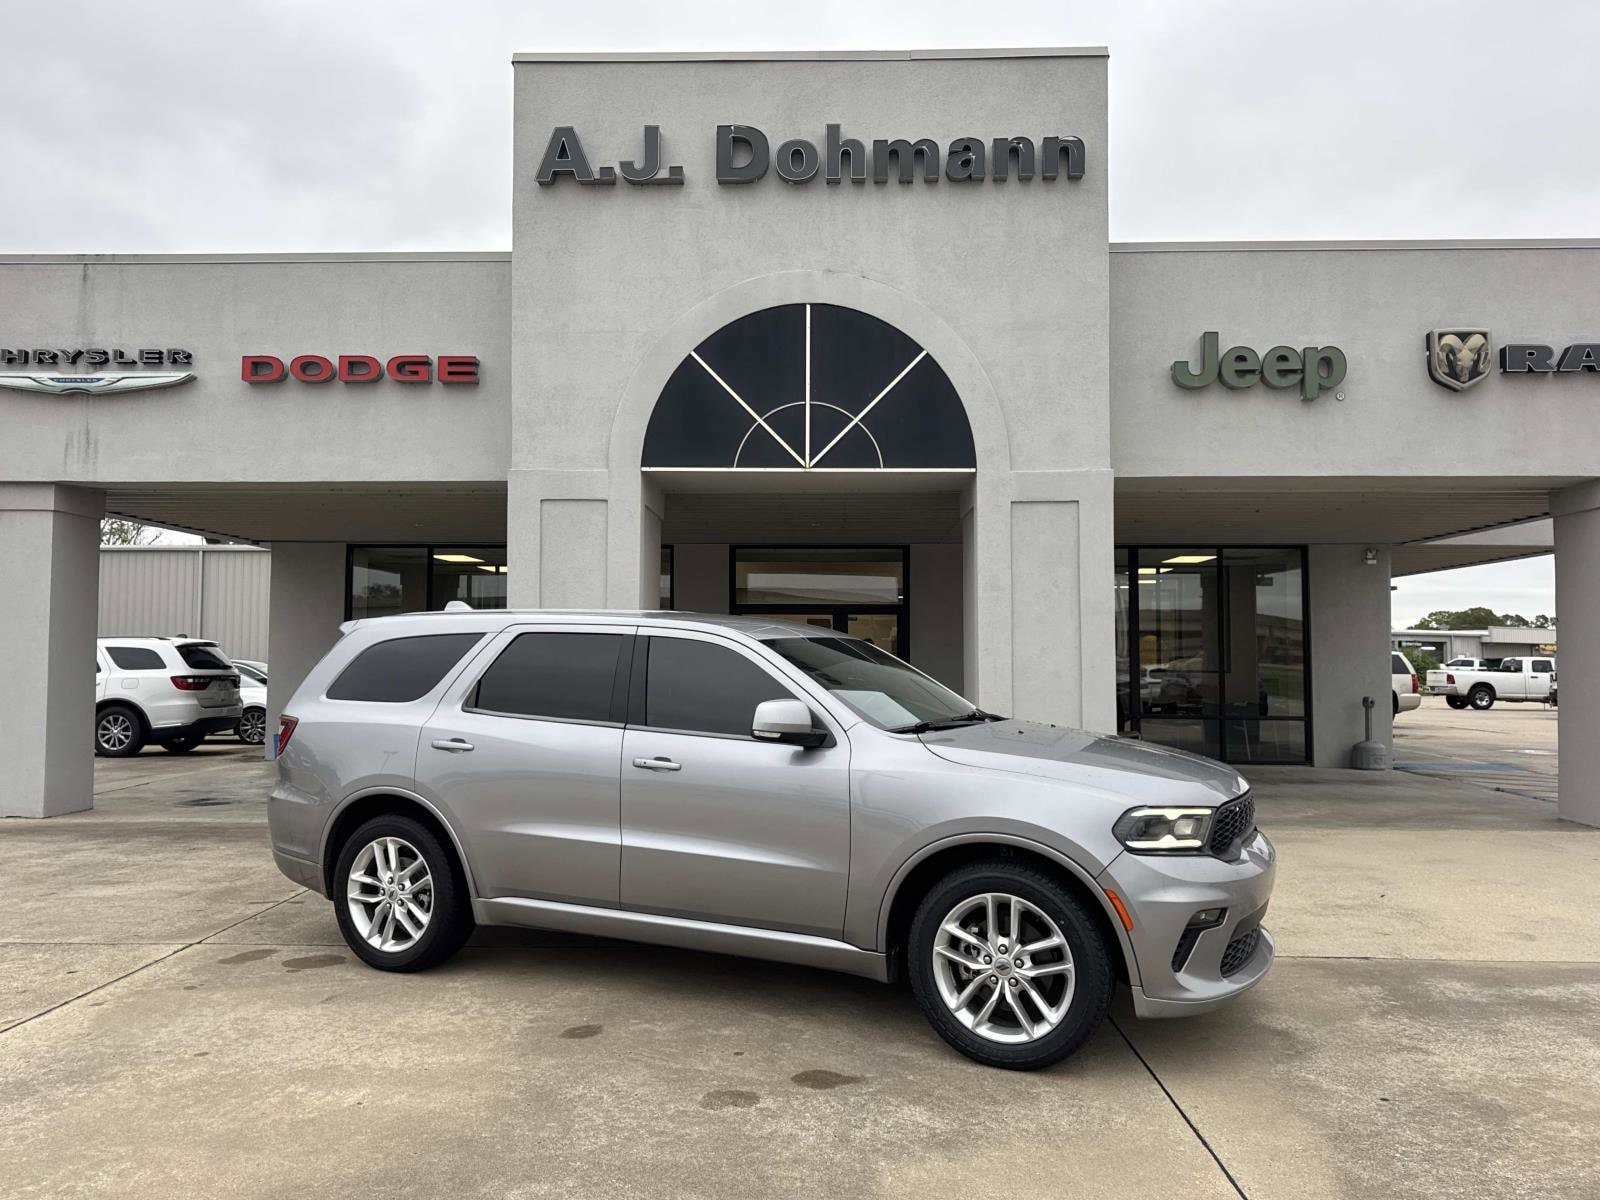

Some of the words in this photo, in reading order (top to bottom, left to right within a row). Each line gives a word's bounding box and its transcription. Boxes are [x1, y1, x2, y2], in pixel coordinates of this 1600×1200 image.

[534, 124, 685, 185] A.J.
[716, 123, 1087, 184] Dohmann
[242, 354, 479, 385] DODGE
[1170, 331, 1348, 401] Jeep
